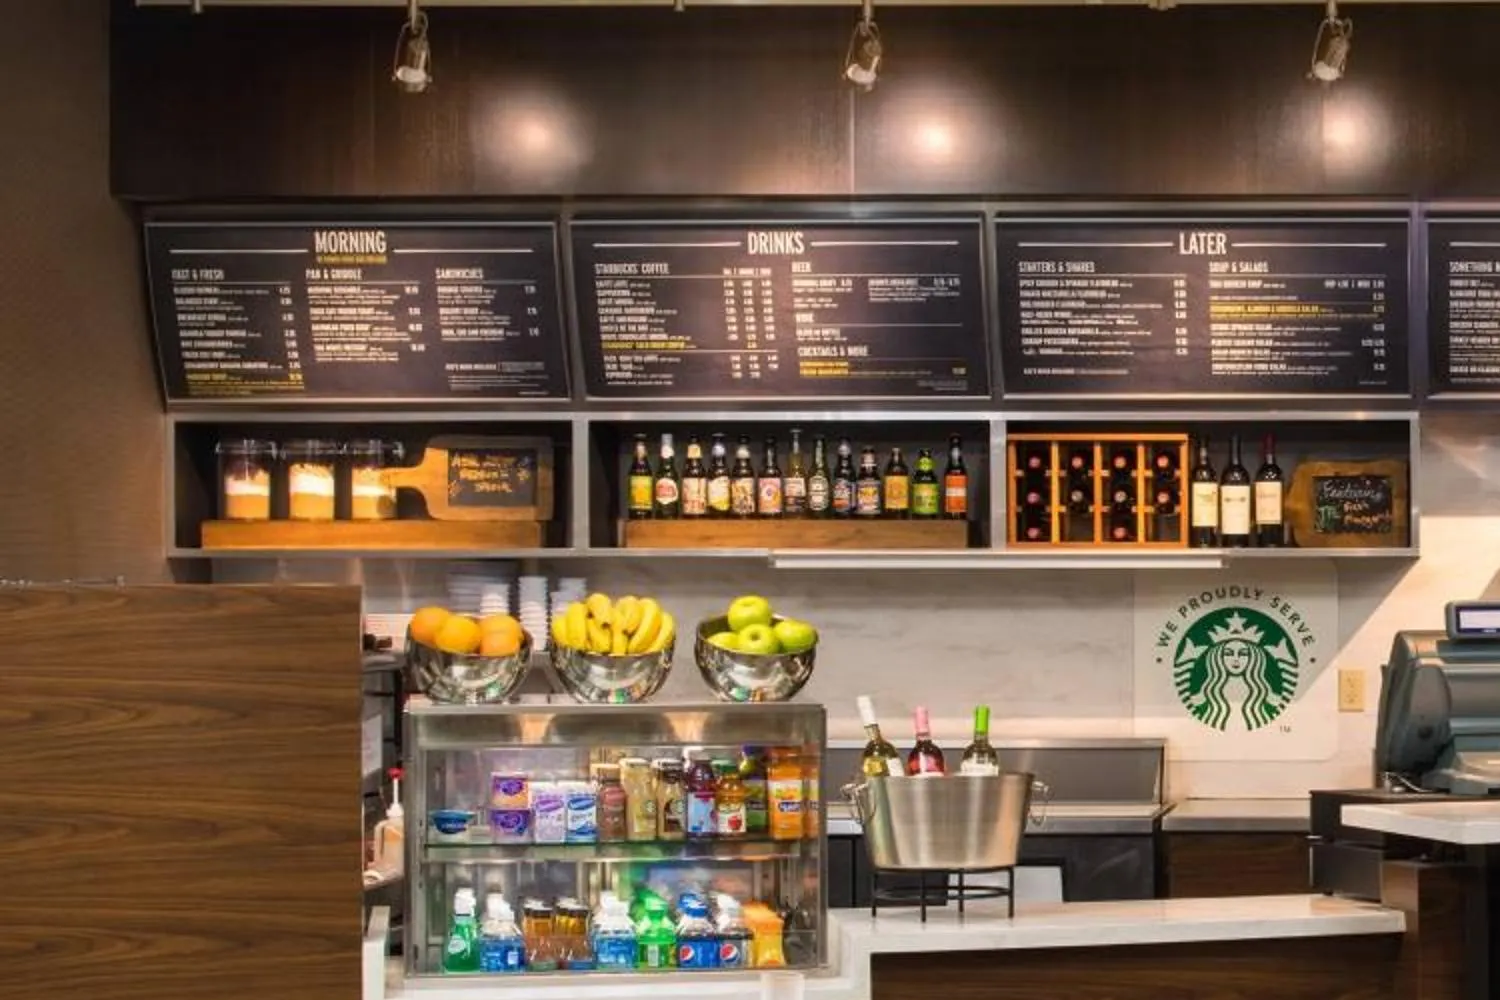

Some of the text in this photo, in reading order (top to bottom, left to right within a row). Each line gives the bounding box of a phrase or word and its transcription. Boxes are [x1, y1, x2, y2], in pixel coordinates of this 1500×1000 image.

[315, 230, 387, 253] MORNING
[747, 232, 804, 255] DRINKS
[1179, 232, 1227, 255] LATER
[1157, 585, 1316, 648] WE PROUDLY SERVE
